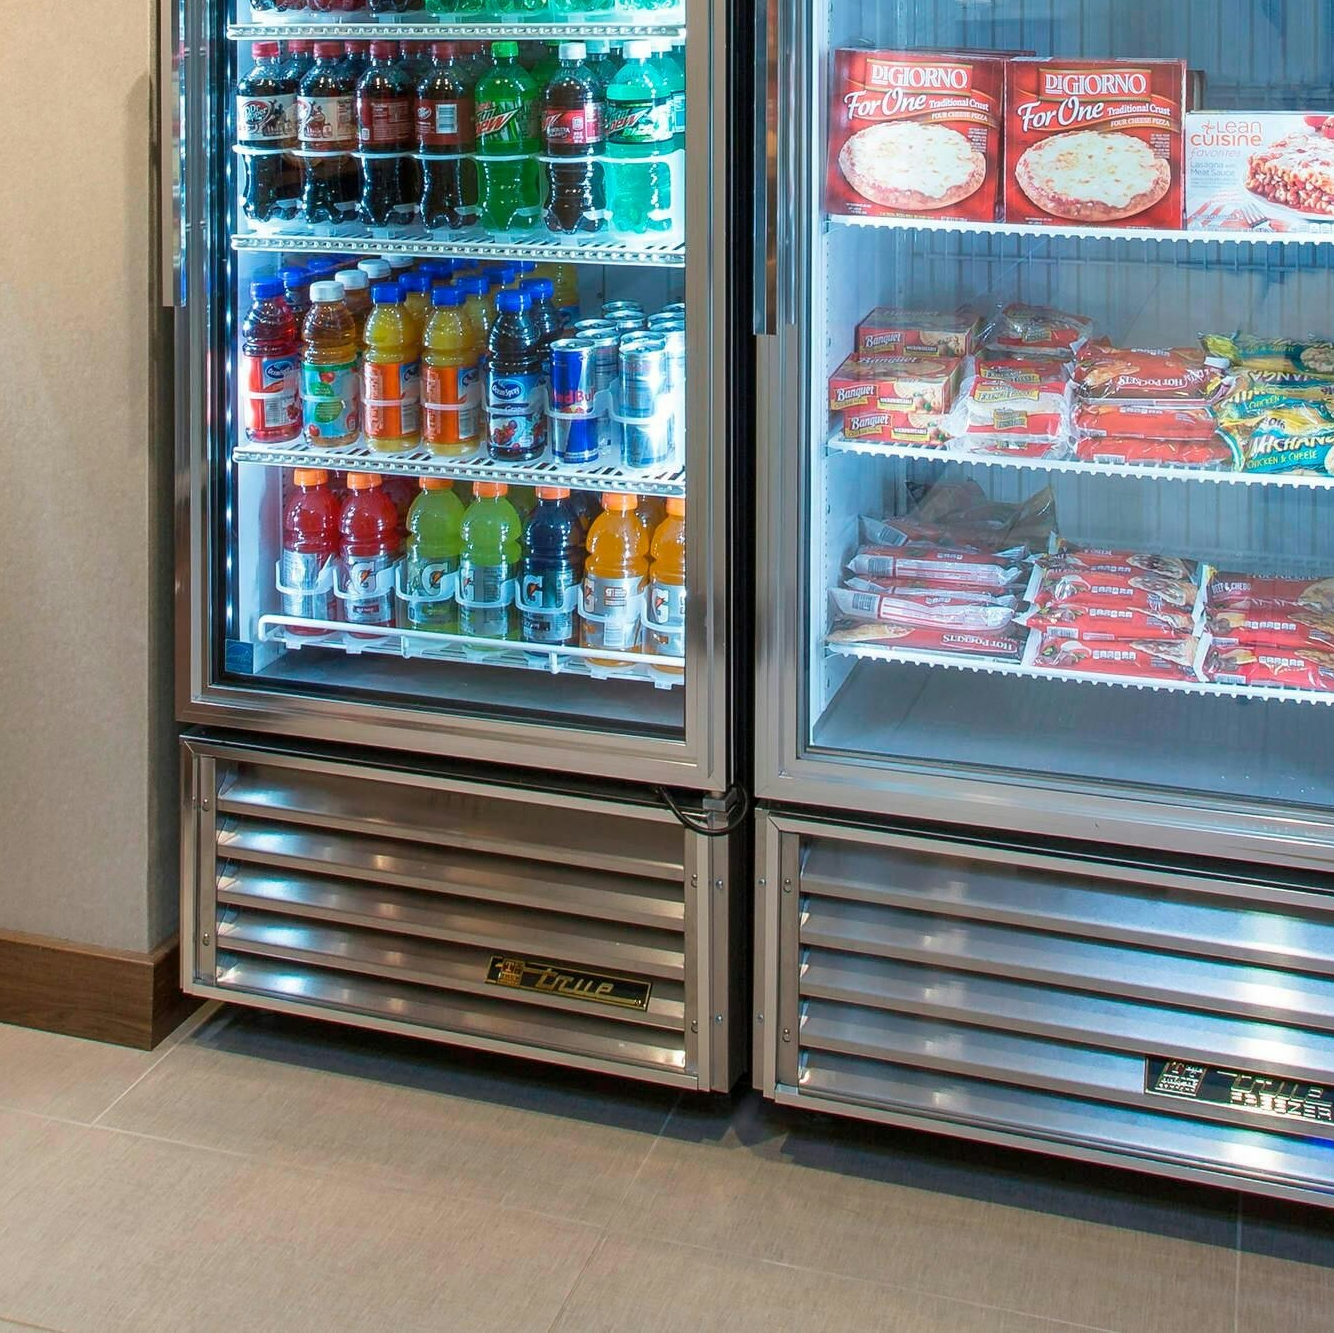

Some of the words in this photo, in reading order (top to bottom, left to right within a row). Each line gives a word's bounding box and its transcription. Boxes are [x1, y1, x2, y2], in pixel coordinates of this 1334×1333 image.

[844, 90, 881, 121] For
[881, 87, 927, 116] One
[929, 98, 969, 109] Traditional
[969, 99, 989, 112] Crust
[1106, 103, 1149, 116] Traditional
[1149, 103, 1172, 116] Crust
[971, 112, 988, 122] PIZZA
[1017, 101, 1058, 133] For
[1057, 96, 1105, 126] One
[1110, 119, 1127, 127] FOUR
[1151, 117, 1171, 127] PIZZA
[1190, 161, 1225, 169] Lasagna
[1190, 168, 1210, 177] Meat
[1211, 168, 1236, 177] Sauce
[864, 332, 902, 348] Banquet
[1117, 374, 1171, 388] POCKETS
[1170, 374, 1184, 388] HOT
[836, 385, 875, 400] Banquet
[850, 414, 890, 430] Banquet
[1247, 455, 1279, 469] CHICKEN
[1288, 449, 1318, 462] CHEESE
[942, 633, 995, 648] POCKETS
[995, 639, 1013, 651] HOT
